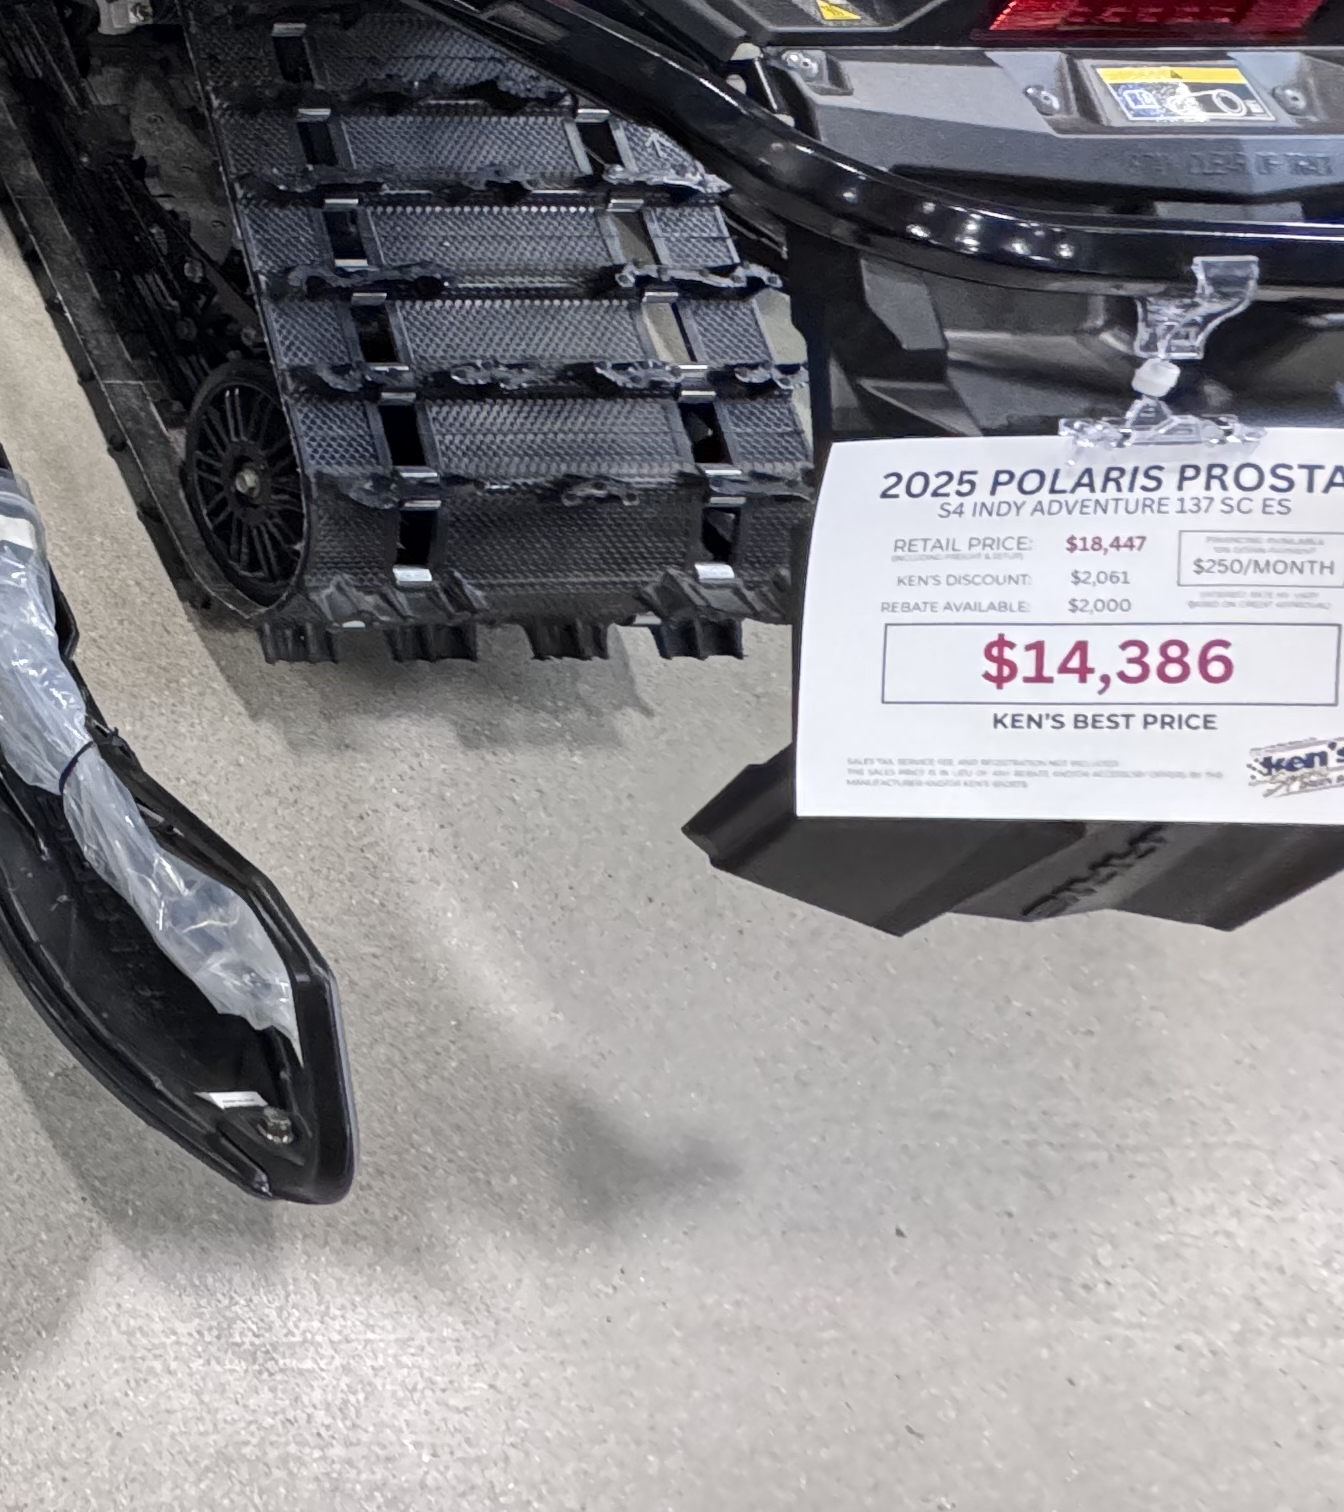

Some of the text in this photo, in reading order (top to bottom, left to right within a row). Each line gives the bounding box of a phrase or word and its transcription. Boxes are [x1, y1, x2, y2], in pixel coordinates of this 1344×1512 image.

[879, 462, 1344, 499] 2025 POLARIS PROSTA
[937, 496, 1292, 519] S4 INDY ADVENTURE 137 SC ES
[893, 535, 1033, 553] RETAIL PRICE:
[1065, 534, 1147, 556] $18,447
[1192, 557, 1335, 576] $250/MONTH
[896, 574, 942, 587] KEN'S
[1070, 569, 1131, 588] $2,061
[880, 601, 939, 613] REBATE
[1067, 598, 1132, 615] $2,000
[981, 633, 1234, 695] $14,386
[992, 712, 1219, 731] KEN'S BEST PRICE
